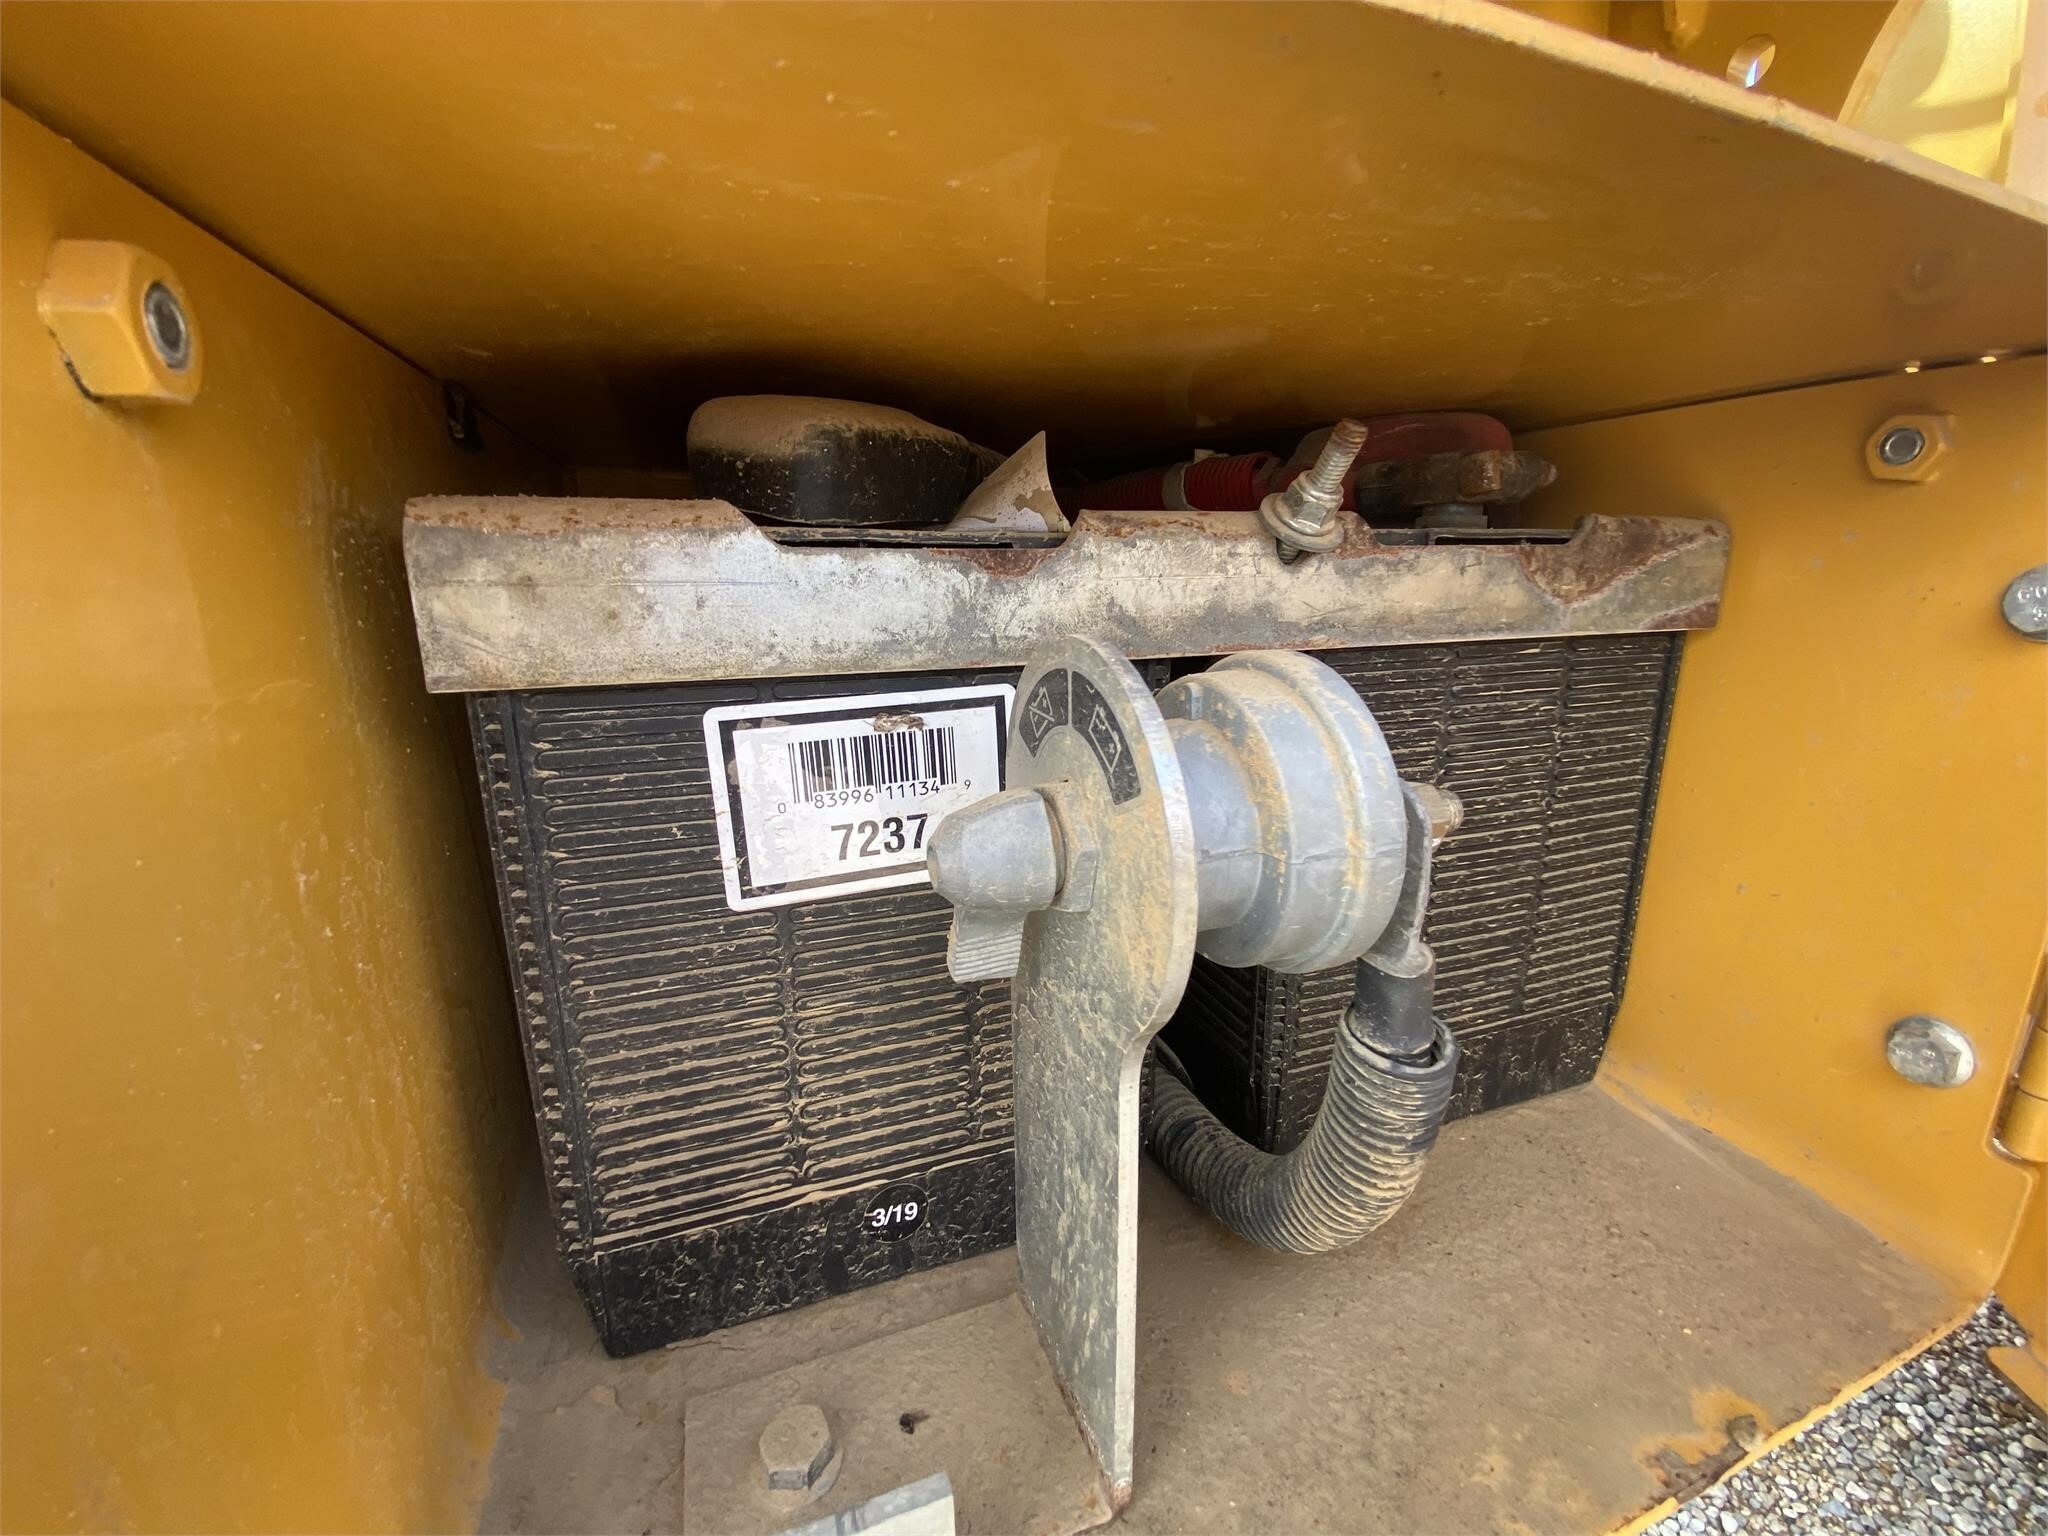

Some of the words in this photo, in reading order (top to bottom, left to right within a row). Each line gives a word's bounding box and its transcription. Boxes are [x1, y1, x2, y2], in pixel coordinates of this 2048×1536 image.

[777, 802, 787, 814] 0
[814, 788, 874, 809] 83996
[886, 780, 940, 800] 11134
[963, 779, 972, 790] 9
[830, 813, 929, 861] 7237
[871, 1201, 919, 1227] 3/19
